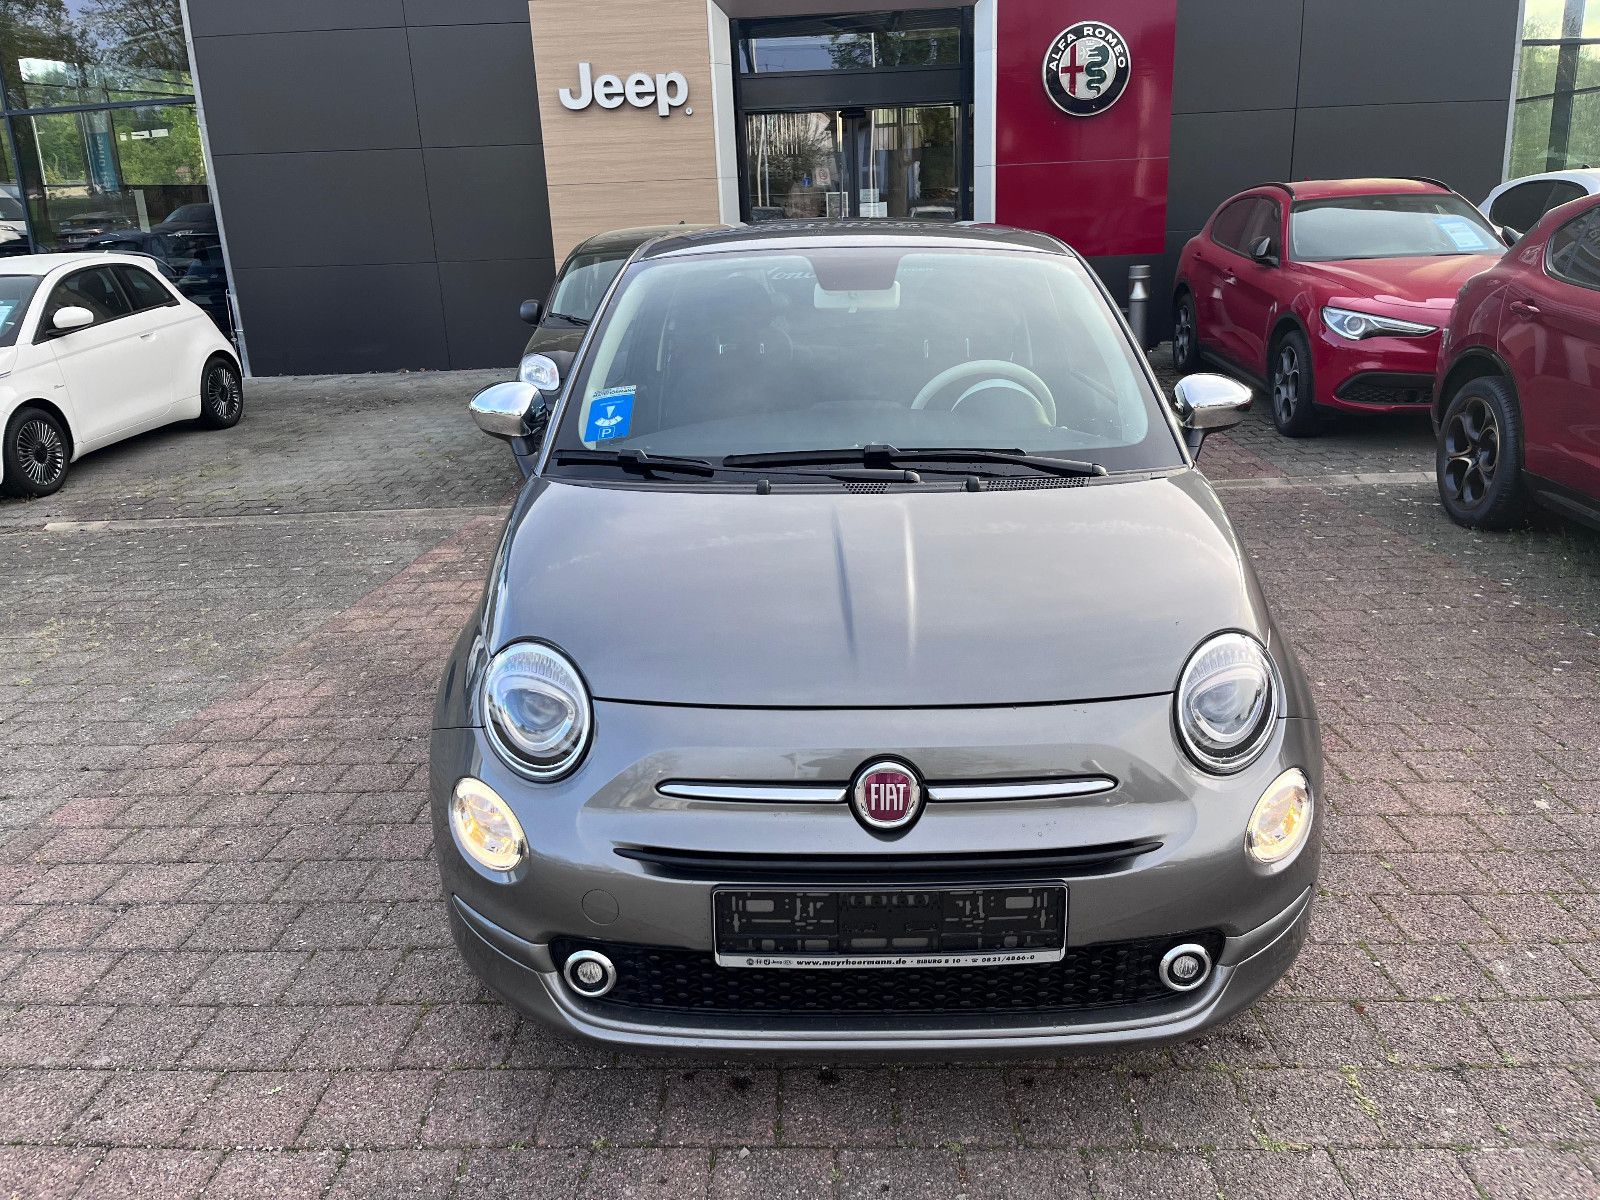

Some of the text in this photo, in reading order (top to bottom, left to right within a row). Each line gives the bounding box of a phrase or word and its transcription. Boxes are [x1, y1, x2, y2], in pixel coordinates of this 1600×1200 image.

[1049, 27, 1126, 71] ALFA ROMEO
[558, 62, 689, 116] Jeep
[601, 428, 612, 438] P
[870, 783, 907, 811] FIAT
[796, 957, 907, 967] www.mayrhoermann.de
[981, 954, 1035, 963] 0821/4866-0
